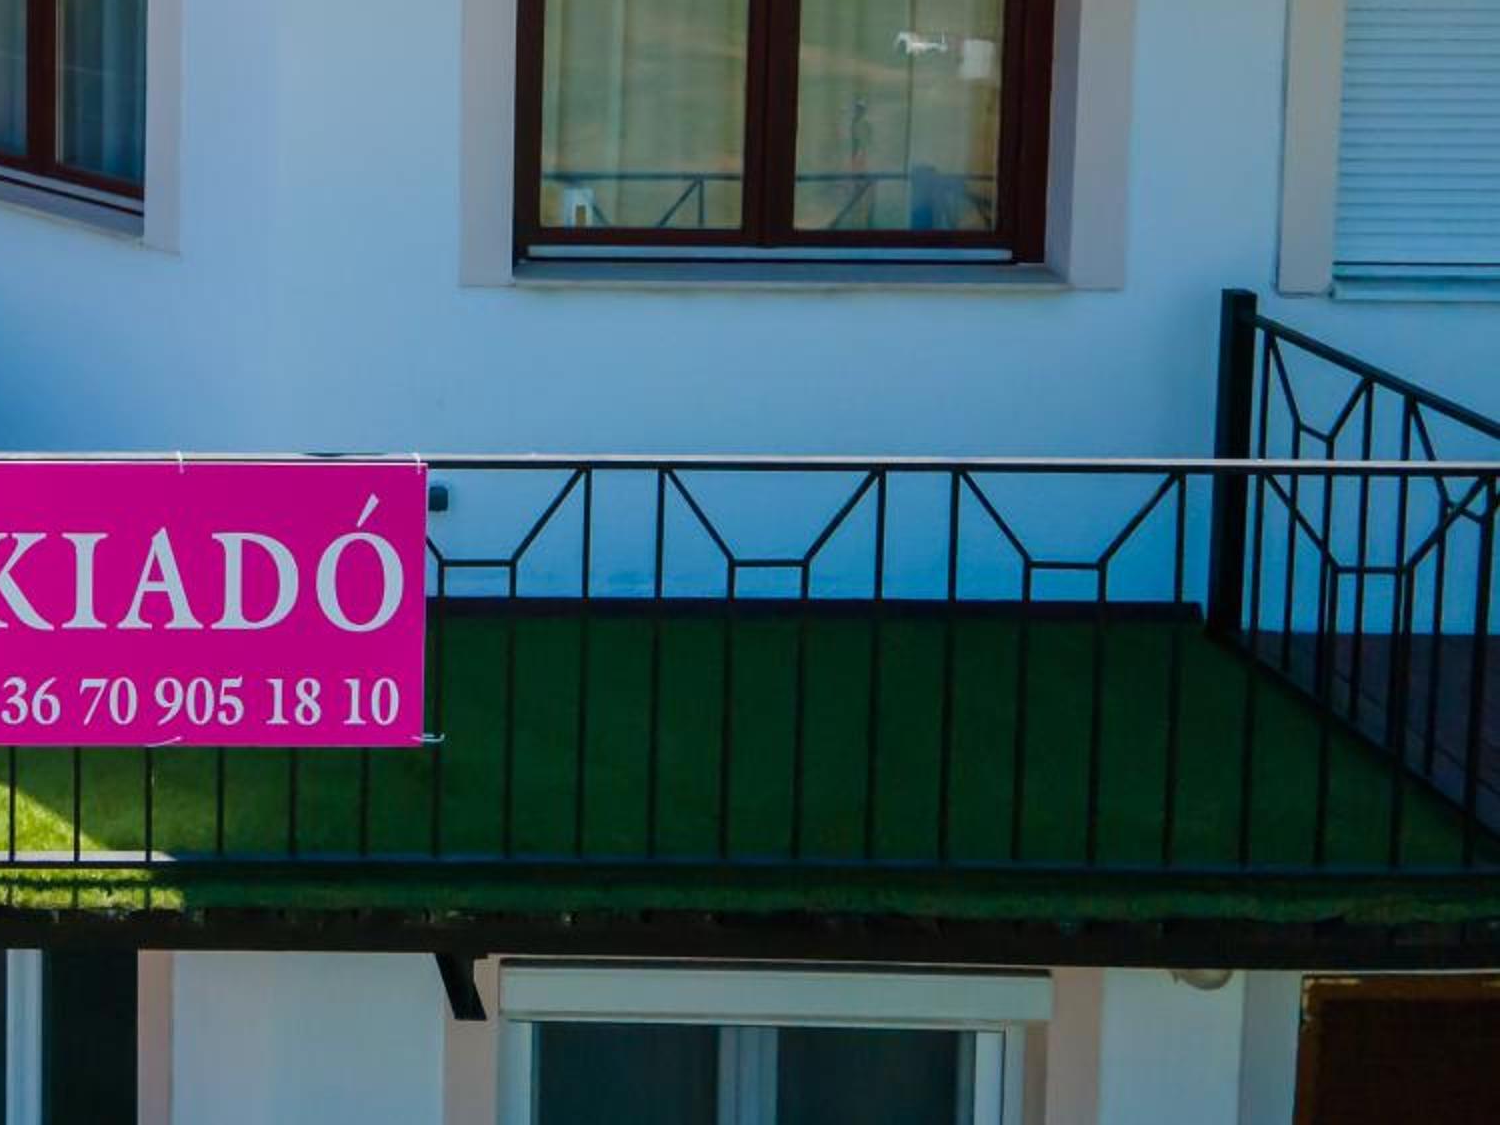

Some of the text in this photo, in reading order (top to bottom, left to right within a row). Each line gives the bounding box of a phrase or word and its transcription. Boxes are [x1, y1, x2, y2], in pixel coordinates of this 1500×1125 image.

[79, 676, 138, 726] 70
[154, 676, 245, 726] 905
[265, 677, 322, 726] 18
[343, 677, 400, 726] 10
